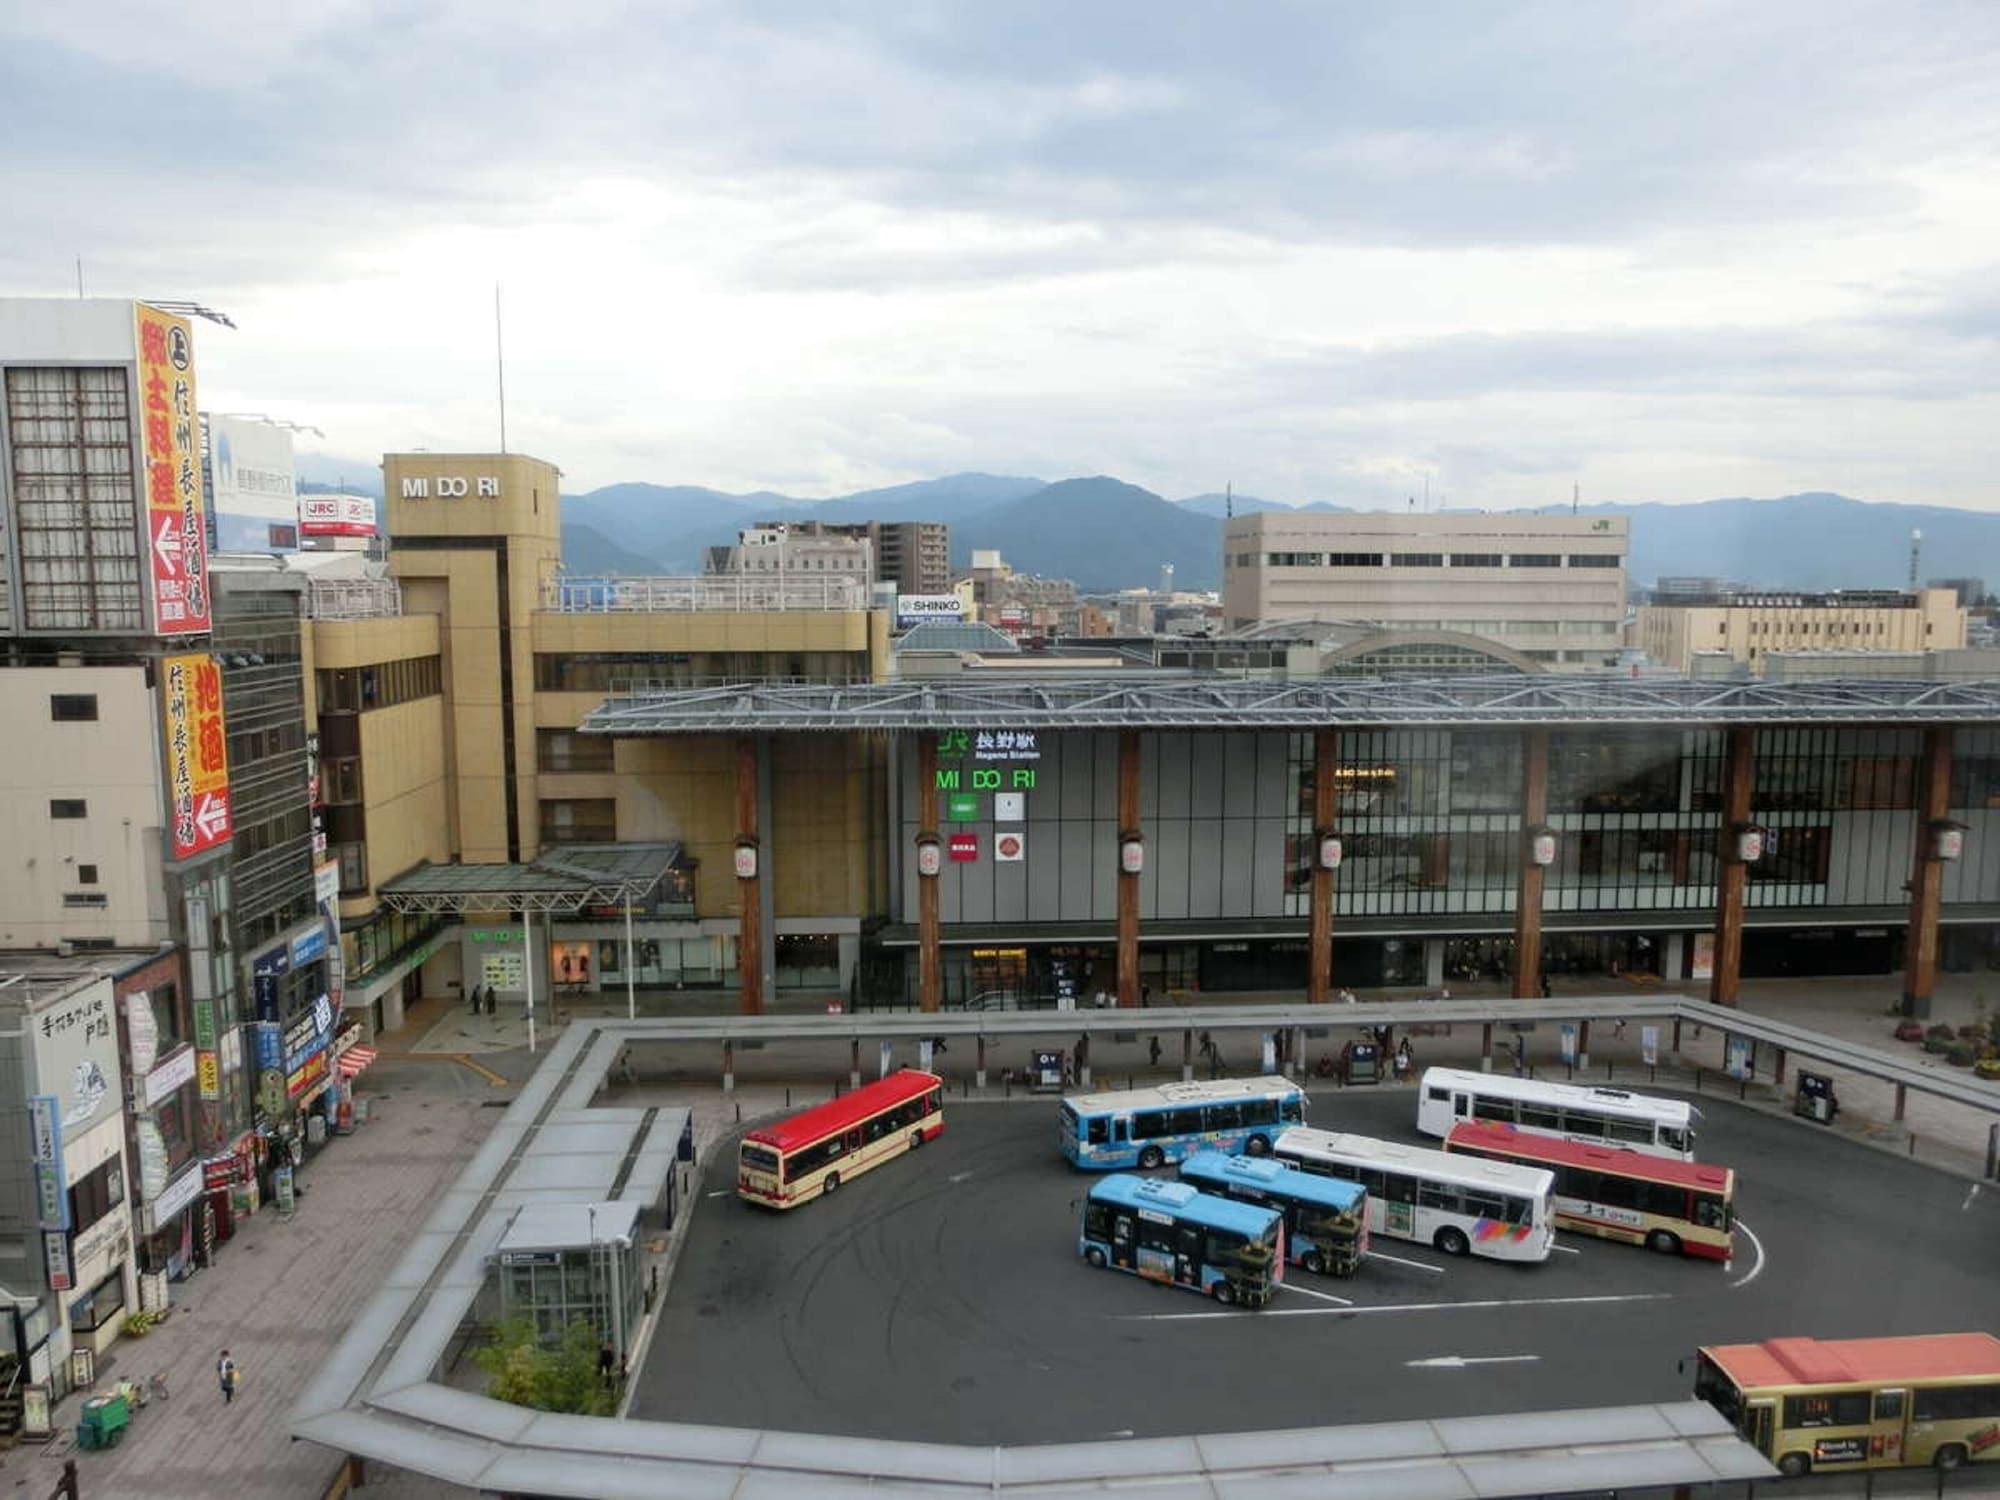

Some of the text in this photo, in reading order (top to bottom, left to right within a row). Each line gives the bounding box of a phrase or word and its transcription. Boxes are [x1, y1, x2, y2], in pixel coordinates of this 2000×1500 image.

[309, 504, 334, 514] JRC
[913, 600, 961, 611] SHINKO
[975, 731, 1035, 749] 長野駅
[936, 770, 1035, 788] MI DO RI
